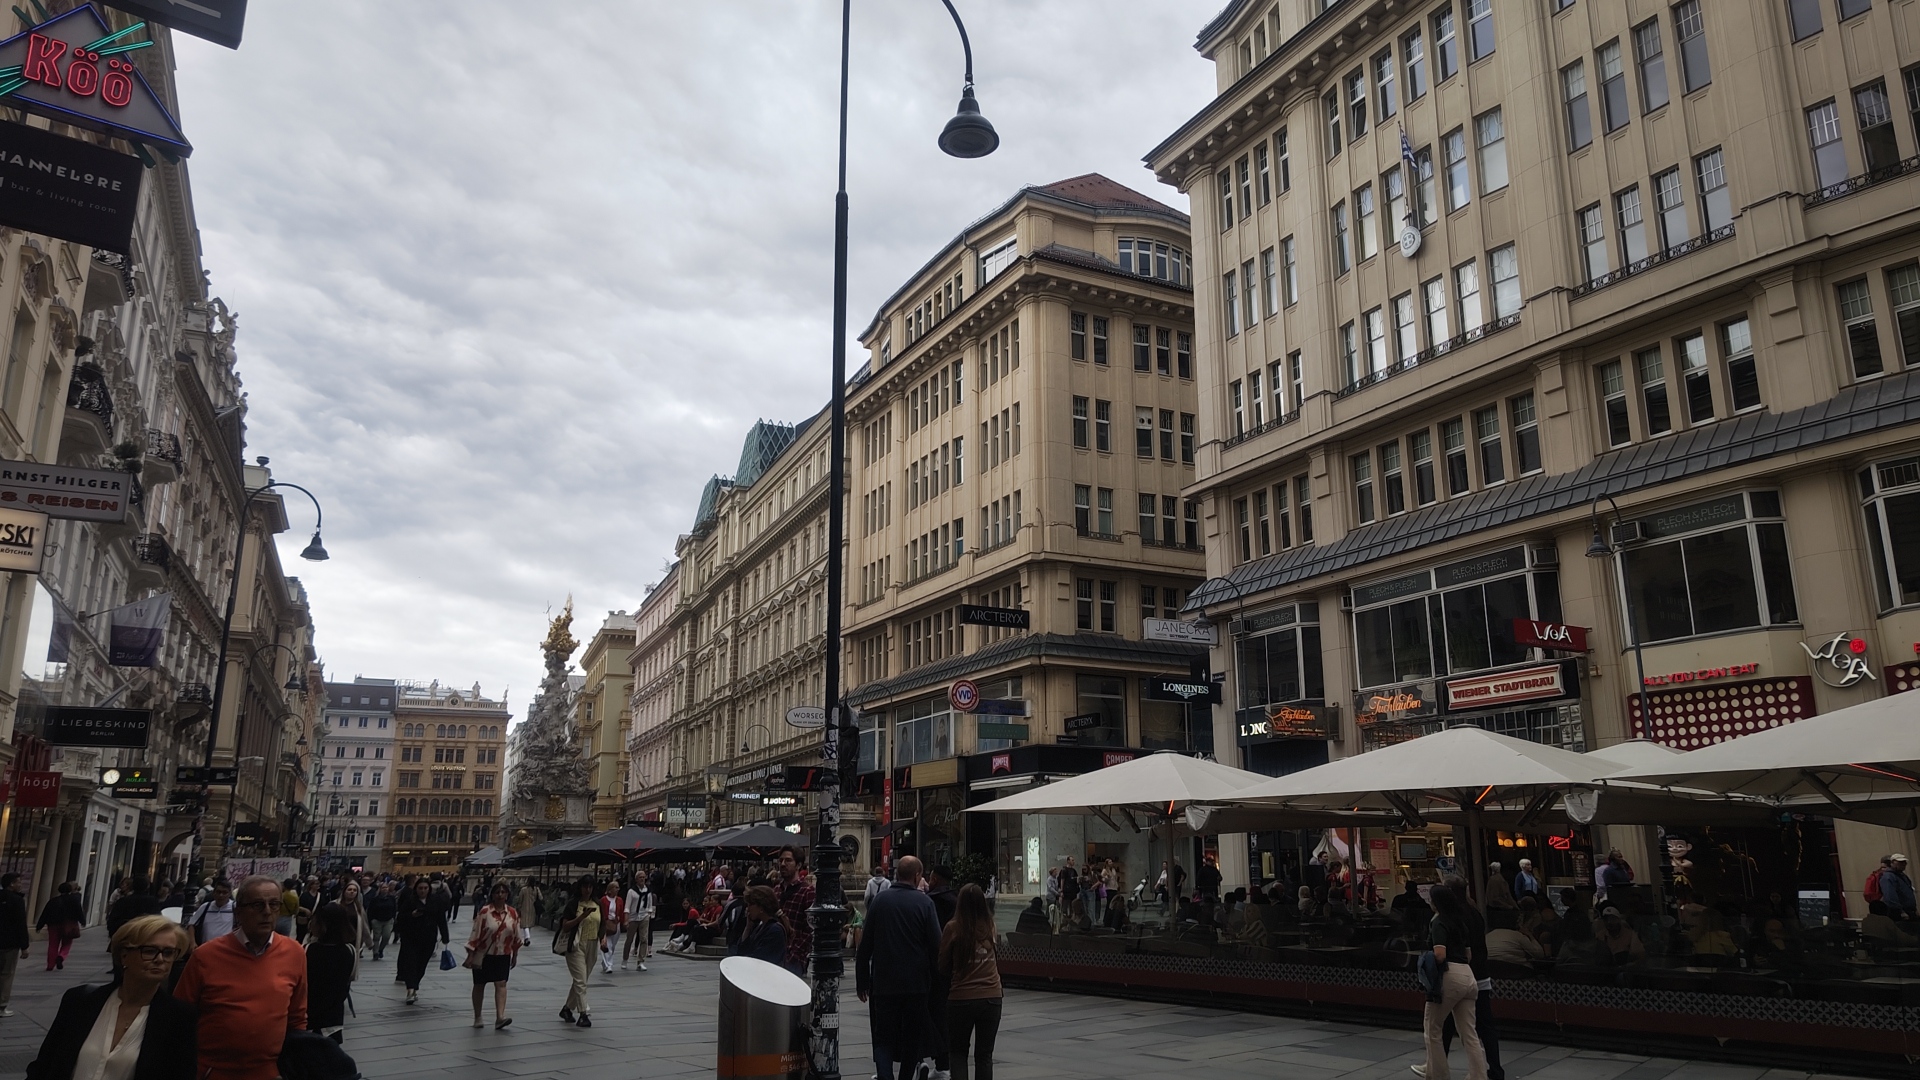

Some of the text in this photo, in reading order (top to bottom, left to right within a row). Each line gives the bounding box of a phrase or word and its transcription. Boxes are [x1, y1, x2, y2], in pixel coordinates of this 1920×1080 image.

[24, 33, 134, 106] Köö
[11, 182, 30, 192] bar
[50, 192, 84, 207] living
[89, 203, 117, 214] room
[2, 470, 121, 490] RNST HILGER
[1, 491, 119, 512] S REISEN
[1657, 502, 1736, 527] PLECH & PLECH
[0, 523, 34, 545] SKI
[0, 548, 33, 556] RÖTCHEN
[1643, 662, 1759, 686] ALL YOU CAN EAT
[1162, 682, 1209, 695] LONGINES
[1453, 675, 1555, 699] WIENER STADTBRÄU
[1369, 694, 1422, 714] Tuchlauben
[61, 719, 147, 729] LIEBESKIND
[793, 712, 824, 720] WORSEG
[992, 755, 1009, 770] CAMPER
